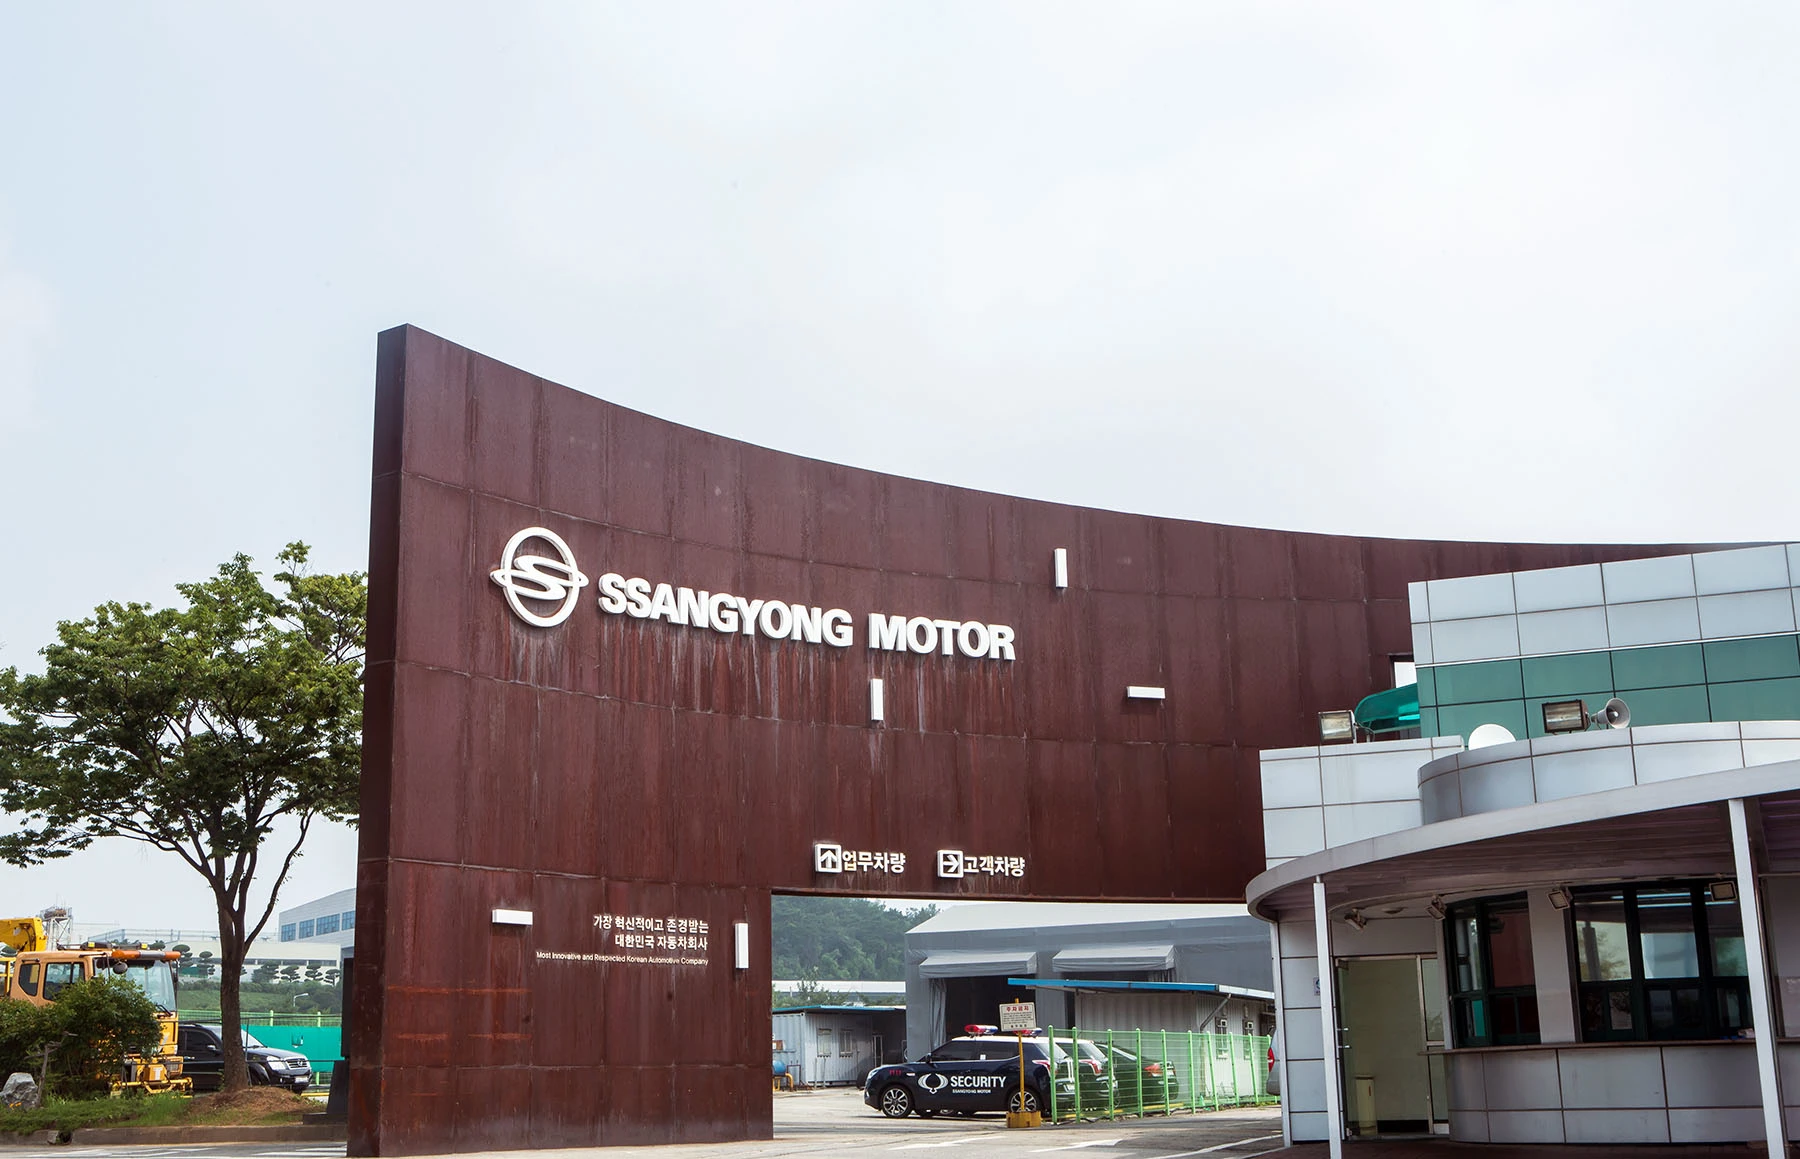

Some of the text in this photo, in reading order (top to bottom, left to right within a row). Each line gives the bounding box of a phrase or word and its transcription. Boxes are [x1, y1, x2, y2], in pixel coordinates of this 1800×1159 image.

[599, 572, 1017, 662] SSANGYONG MOTOR
[842, 851, 906, 874] 업무차량
[964, 856, 1025, 877] 고객차량
[593, 914, 709, 934] 가장 혁신적이고 존경받는
[615, 934, 708, 951] 대한민국 자동차회사
[536, 951, 551, 960] Most
[552, 952, 581, 961] Innovative
[594, 954, 625, 963] Respected
[626, 955, 648, 964] Korean
[648, 956, 680, 965] Automotive
[680, 957, 709, 966] Company
[950, 1075, 1007, 1088] SECURITY
